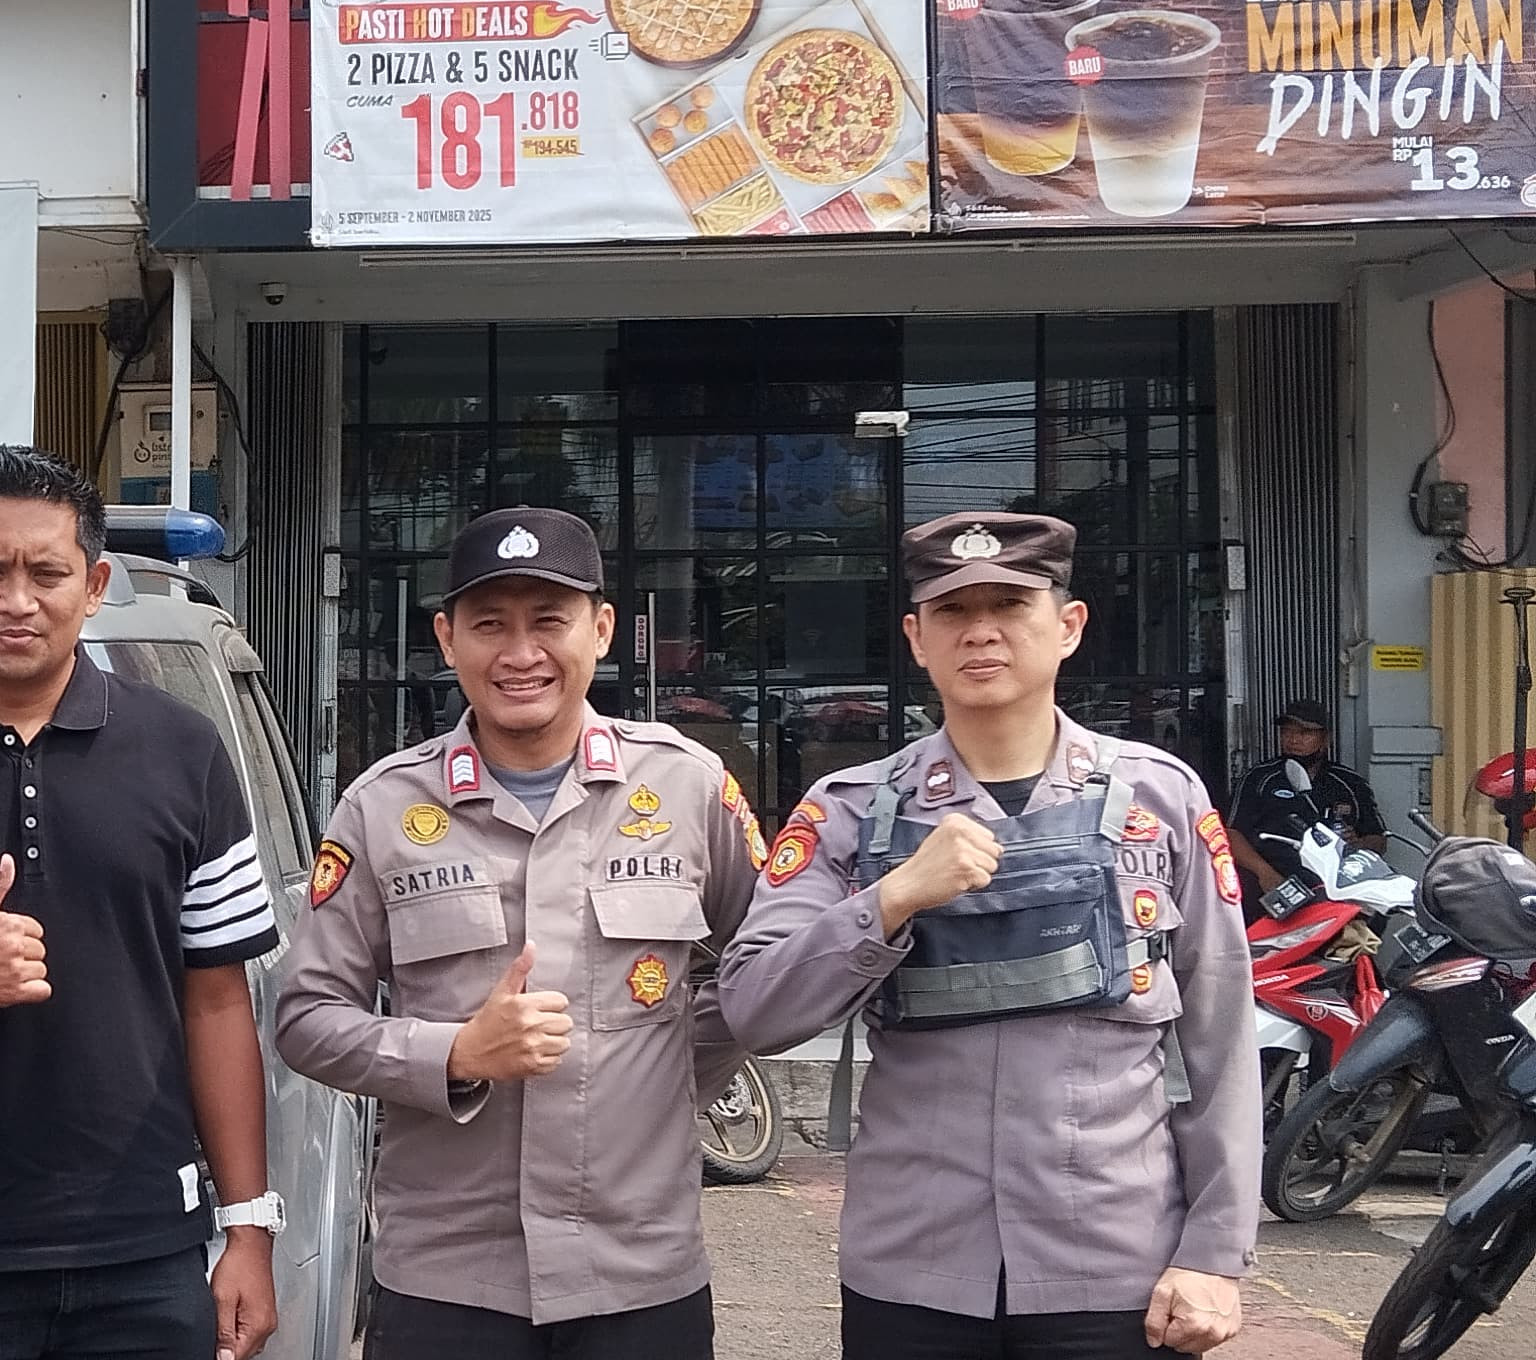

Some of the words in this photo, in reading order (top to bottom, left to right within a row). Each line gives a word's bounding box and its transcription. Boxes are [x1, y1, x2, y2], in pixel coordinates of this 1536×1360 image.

[345, 9, 405, 40] PASTI
[414, 7, 455, 40] HOT
[463, 5, 529, 38] DEALS
[348, 52, 362, 86] 2
[371, 51, 435, 85] PIZZA
[445, 51, 464, 83] &
[474, 50, 488, 83] 5
[499, 47, 579, 81] SNACK
[1068, 55, 1101, 76] BARU
[347, 94, 395, 108] CUMA
[1256, 39, 1504, 156] DINGIN
[1392, 136, 1433, 149] MULAI
[1392, 149, 1413, 162] RP
[339, 212, 345, 225] 5
[347, 211, 399, 224] SEPTEMBER
[416, 210, 465, 223] NOVEMBER
[468, 209, 492, 222] 2025
[393, 864, 475, 896] SATRIA
[610, 857, 681, 879] POLRI
[1114, 849, 1172, 882] OLR
